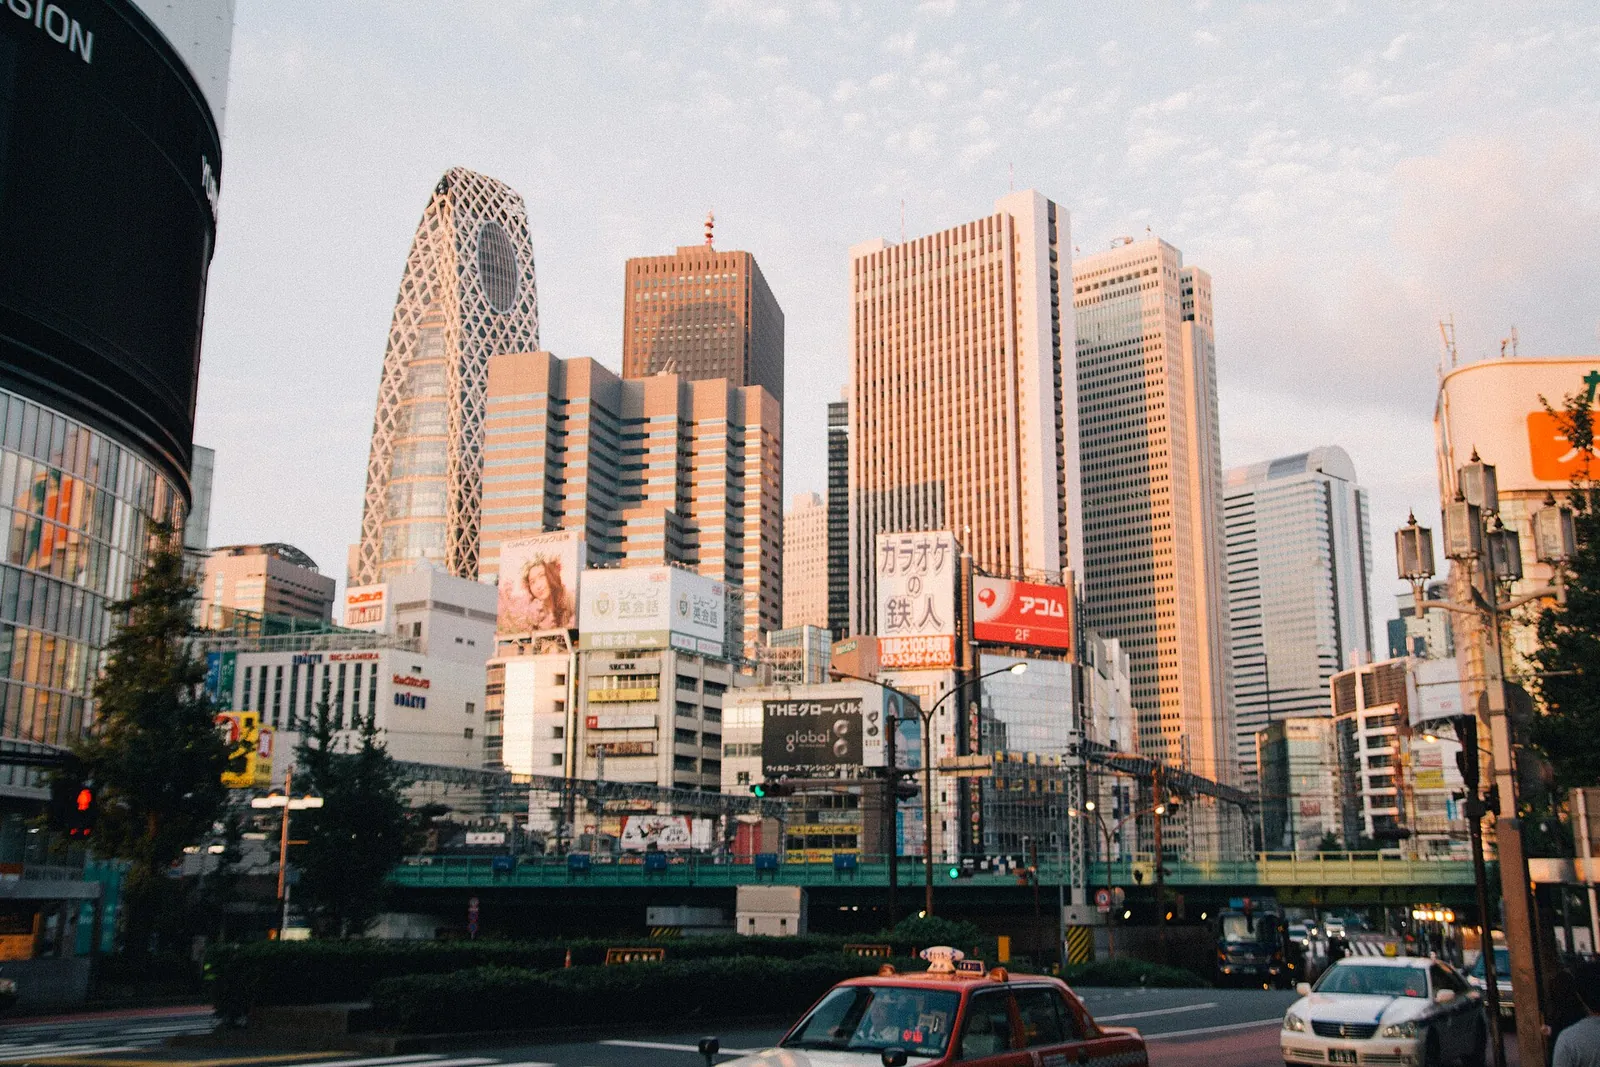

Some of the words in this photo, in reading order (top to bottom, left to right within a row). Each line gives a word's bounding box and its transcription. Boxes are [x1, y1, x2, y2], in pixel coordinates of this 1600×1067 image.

[0, 0, 93, 64] SION
[880, 537, 949, 574] カラオケ
[908, 576, 922, 595] の
[887, 598, 942, 629] 鉄人
[1019, 596, 1064, 618] アコム
[1015, 628, 1030, 641] 2F
[785, 729, 830, 753] global
